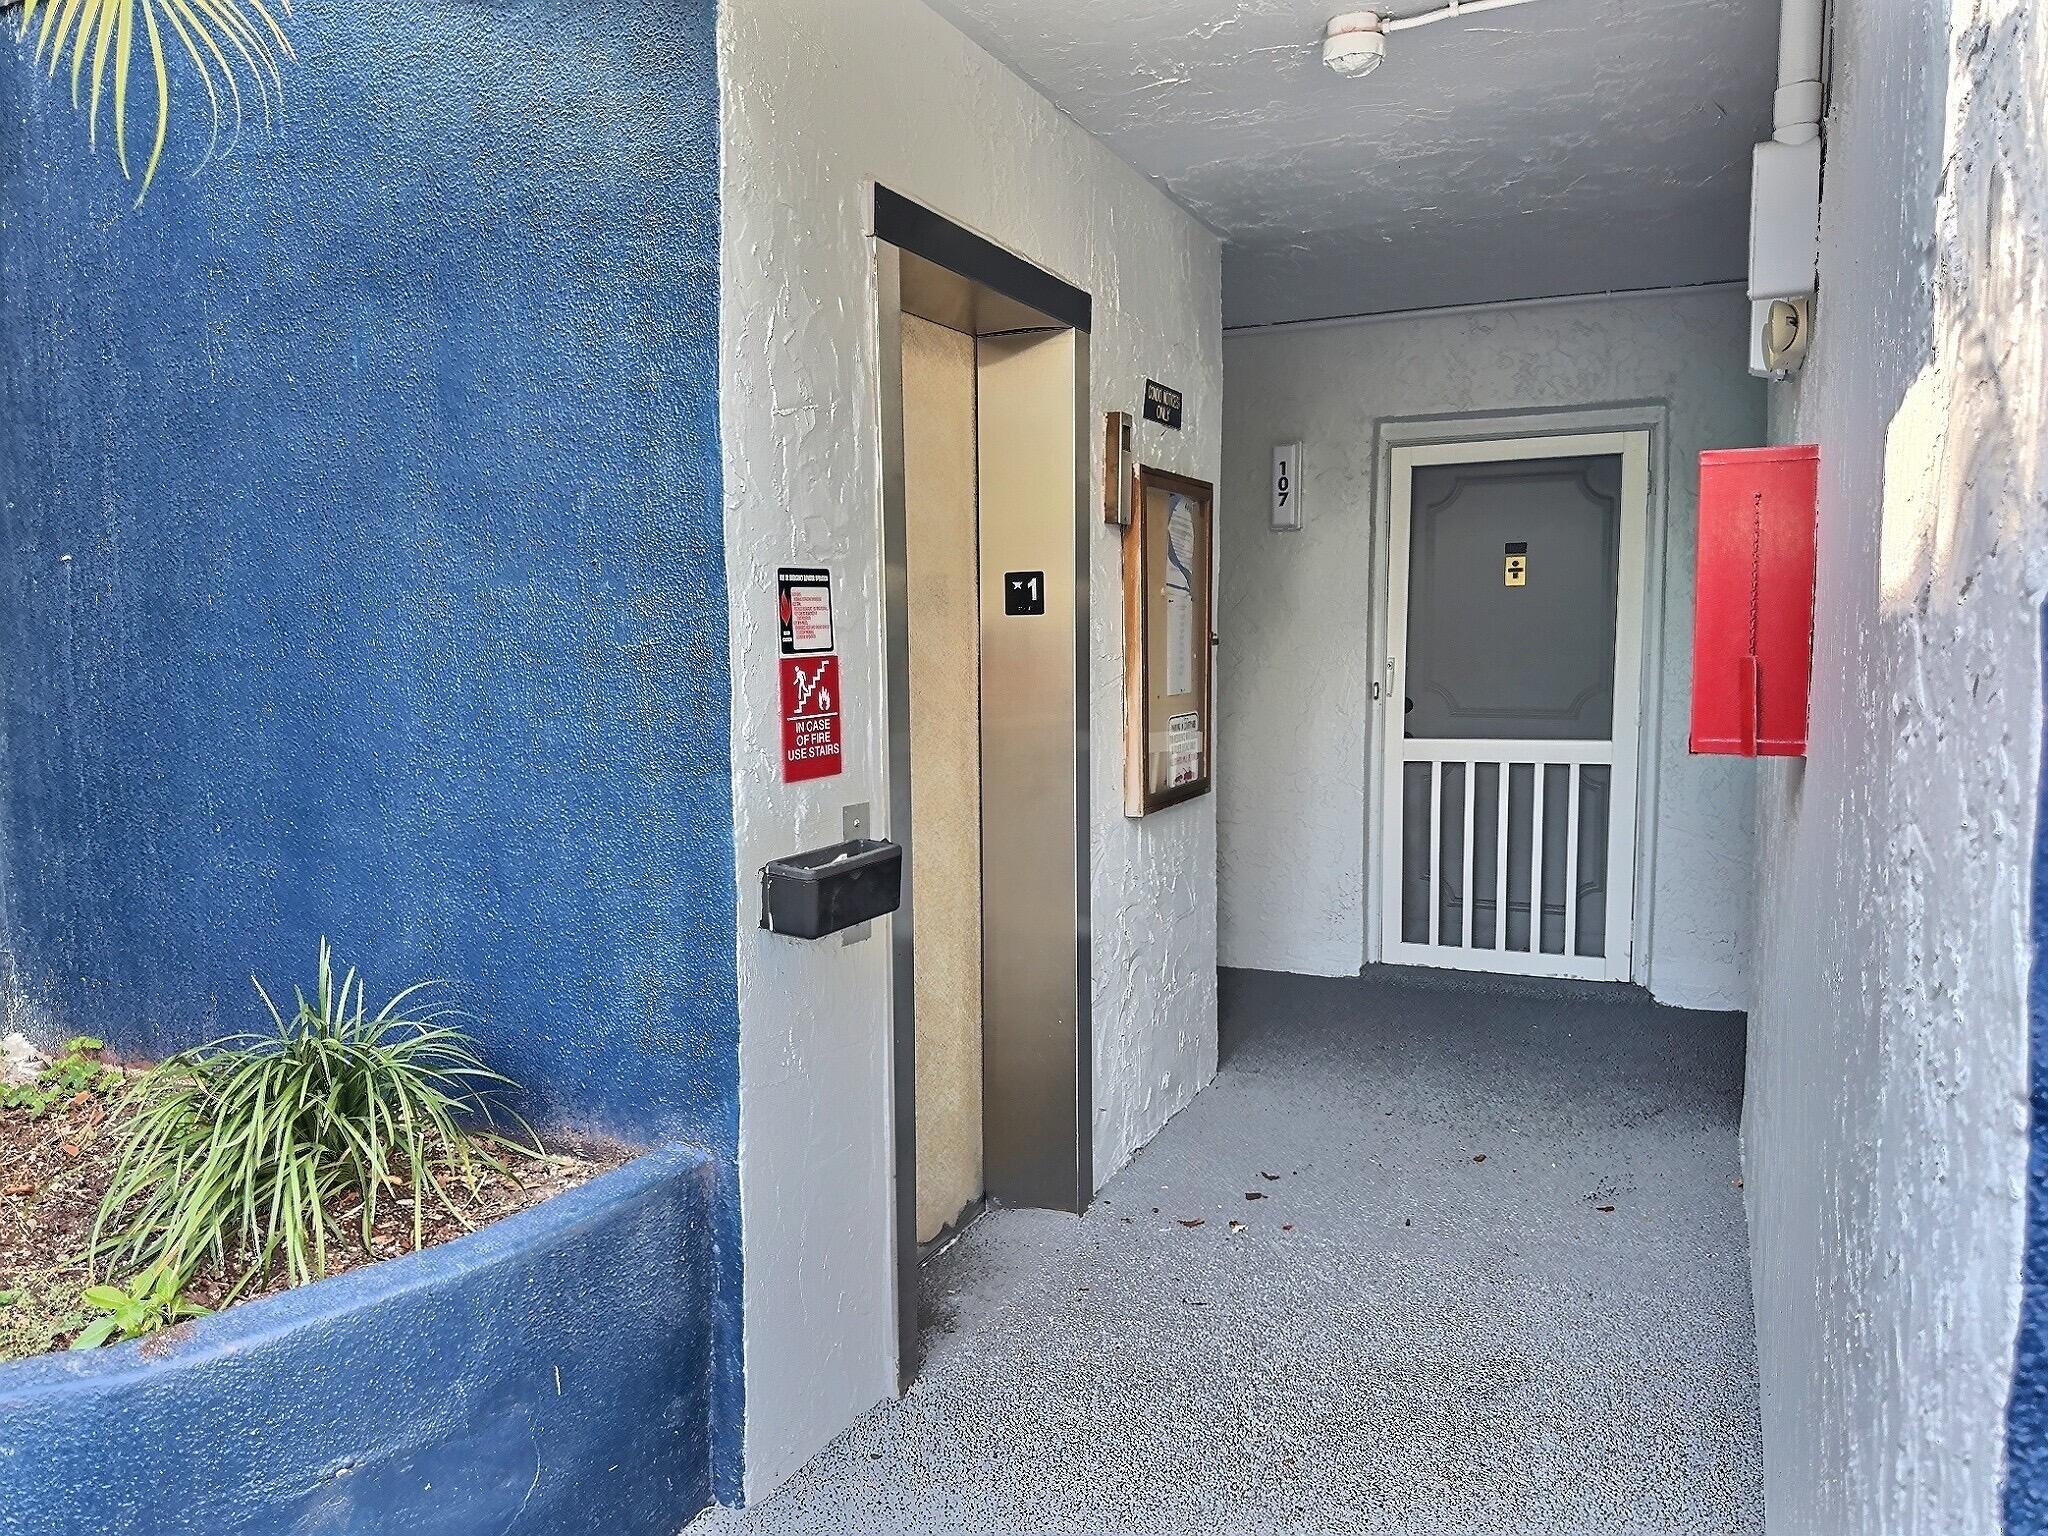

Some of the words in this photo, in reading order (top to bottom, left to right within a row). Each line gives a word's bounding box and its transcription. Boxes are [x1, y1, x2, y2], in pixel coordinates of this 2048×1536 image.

[1278, 461, 1289, 507] 107
[1027, 577, 1037, 601] 1
[795, 722, 805, 734] IN
[806, 719, 831, 732] CASE
[796, 734, 809, 746] OF
[811, 731, 831, 744] FIRE
[787, 748, 807, 761] USE
[808, 743, 840, 758] STAIRS
